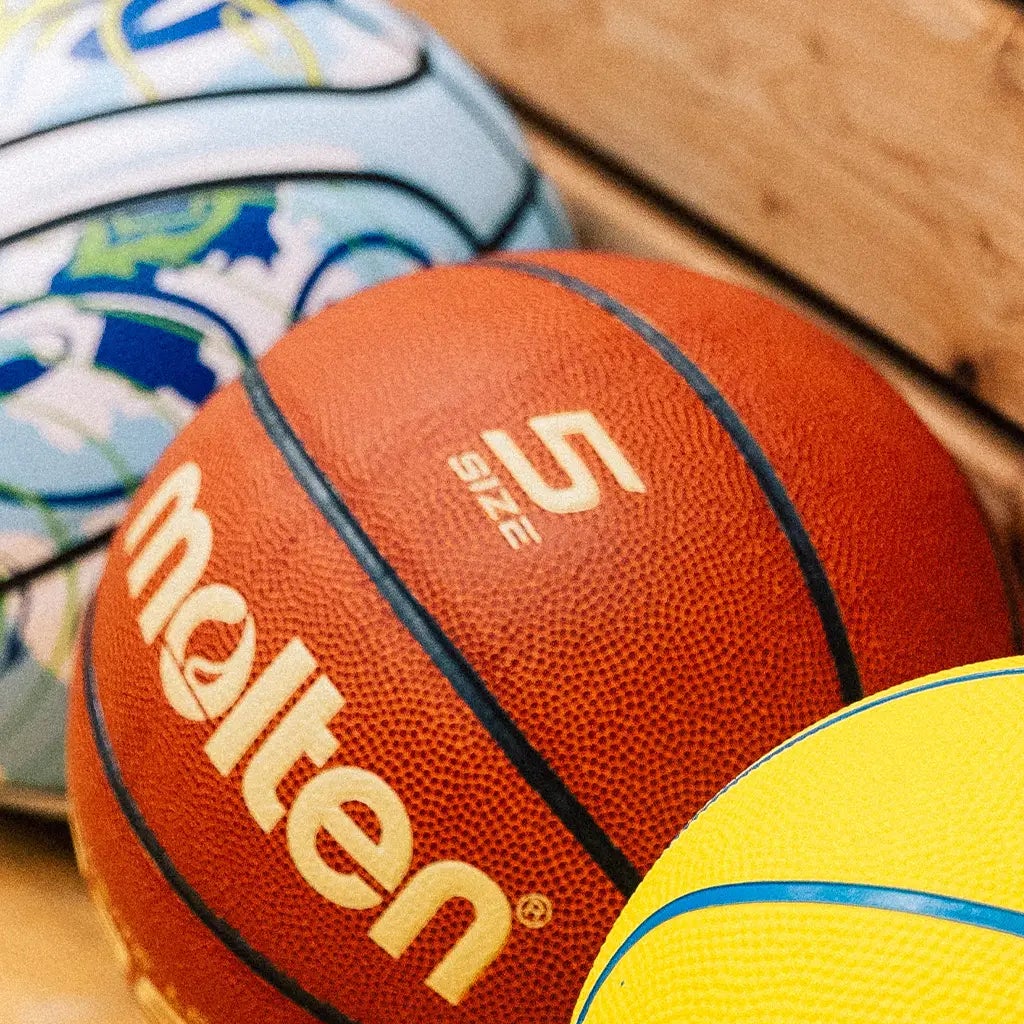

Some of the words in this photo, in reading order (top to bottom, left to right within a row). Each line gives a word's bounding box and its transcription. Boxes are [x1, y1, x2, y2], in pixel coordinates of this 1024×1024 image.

[448, 451, 543, 550] SIZE
[479, 410, 647, 515] 5
[124, 462, 512, 1006] molten
